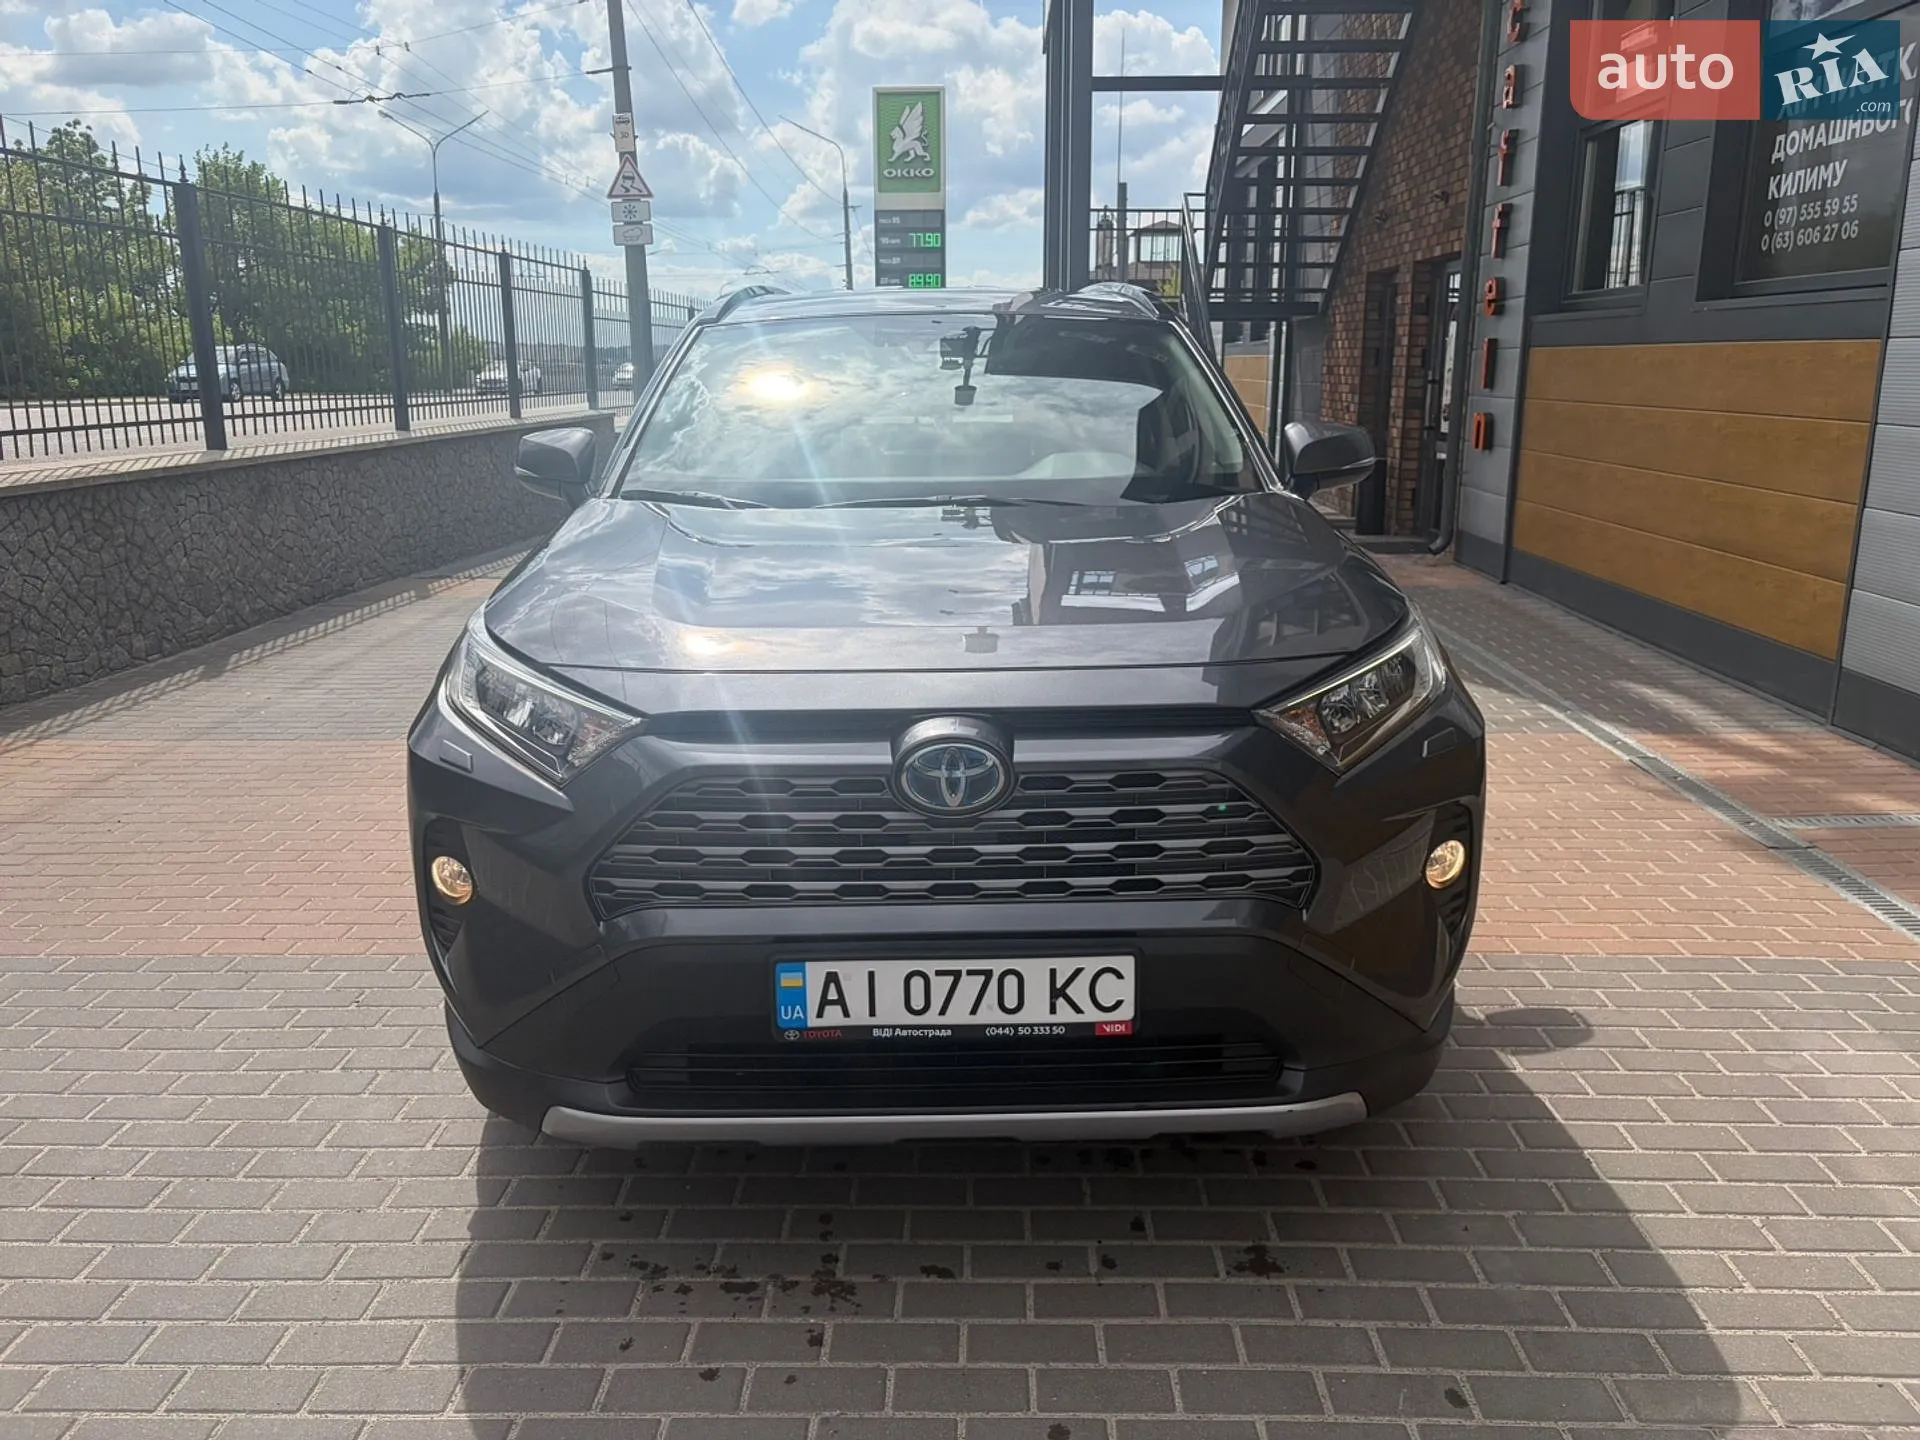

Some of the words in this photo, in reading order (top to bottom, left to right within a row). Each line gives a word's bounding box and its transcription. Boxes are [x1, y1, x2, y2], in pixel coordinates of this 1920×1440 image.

[882, 167, 935, 178] OKKO
[1768, 158, 1849, 200] КИЛИМУ
[1763, 210, 1772, 228] 0
[1774, 205, 1798, 231] (97)
[1799, 200, 1821, 222] 555
[1823, 197, 1840, 218] 59
[1841, 194, 1859, 214] 55
[1761, 234, 1769, 251] 0
[1771, 230, 1795, 254] (63)
[1796, 224, 1821, 246] 606
[1822, 223, 1839, 243] 27
[1841, 220, 1859, 239] 06
[815, 969, 876, 1019] AI
[903, 968, 1025, 1017] 0770
[1049, 966, 1126, 1015] KC
[779, 1005, 804, 1020] UA
[803, 1030, 843, 1039] TOYOTA
[894, 1027, 952, 1039] Автострада
[985, 1026, 1015, 1037] (044)
[1018, 1026, 1031, 1036] 50
[1032, 1026, 1051, 1036] 333
[1052, 1025, 1065, 1035] 50
